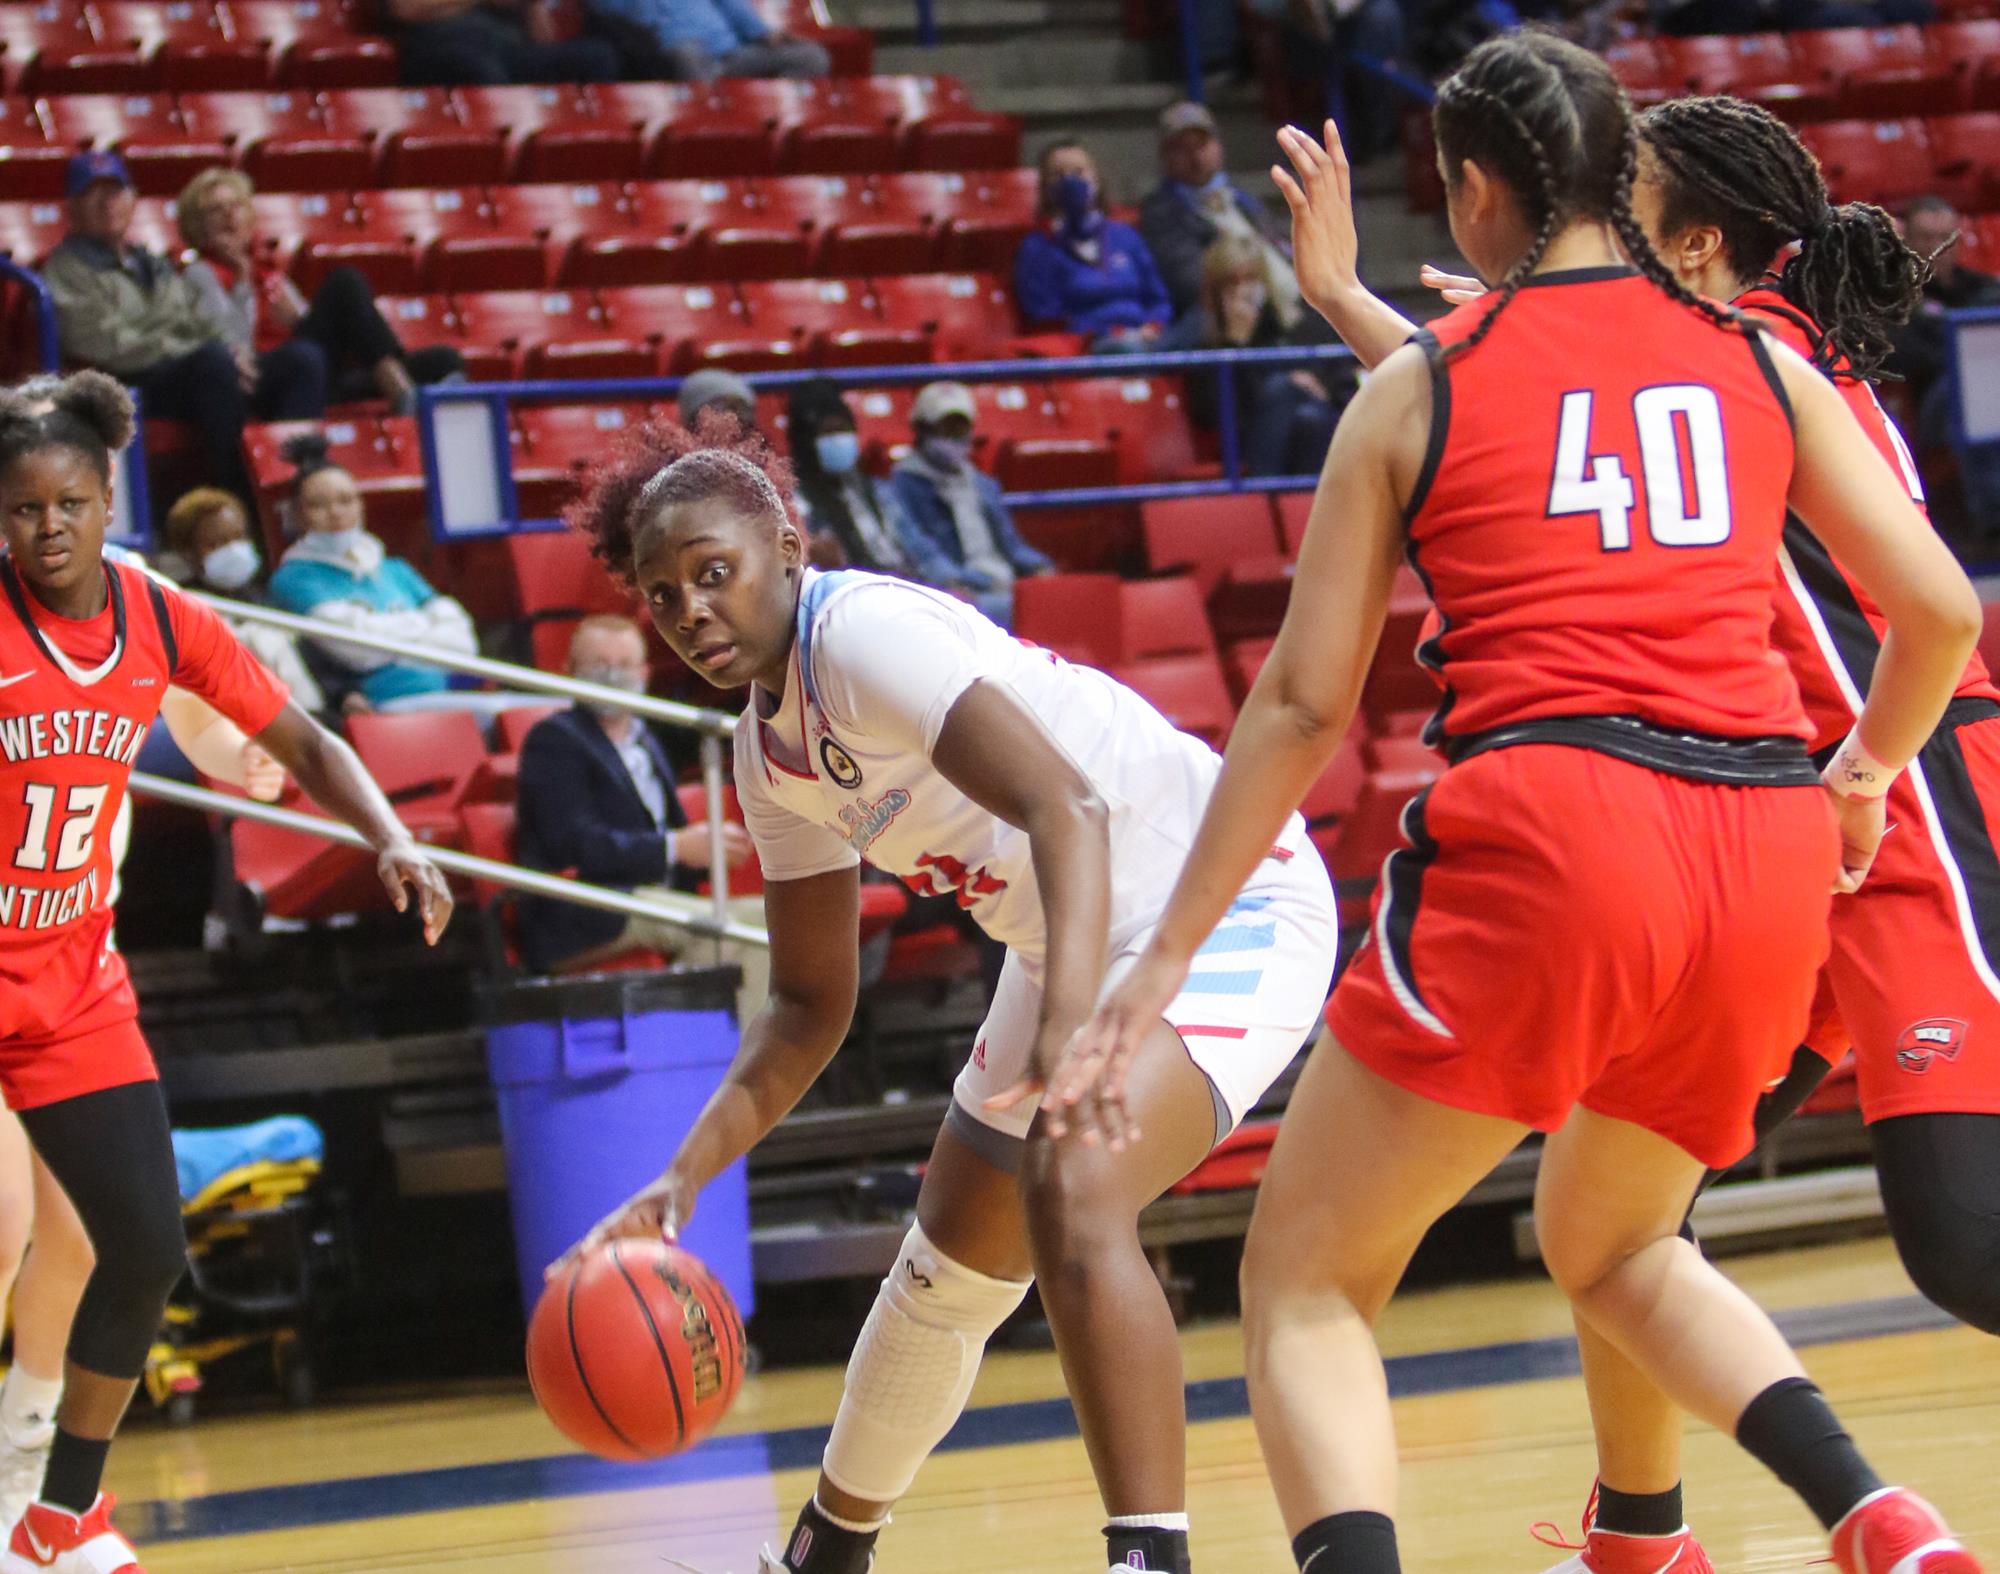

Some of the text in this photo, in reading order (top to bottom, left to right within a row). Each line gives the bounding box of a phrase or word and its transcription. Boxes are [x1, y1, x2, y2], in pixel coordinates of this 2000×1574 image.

[1545, 382, 1732, 553] 40
[0, 709, 146, 766] WESTERN
[13, 781, 109, 872] 12
